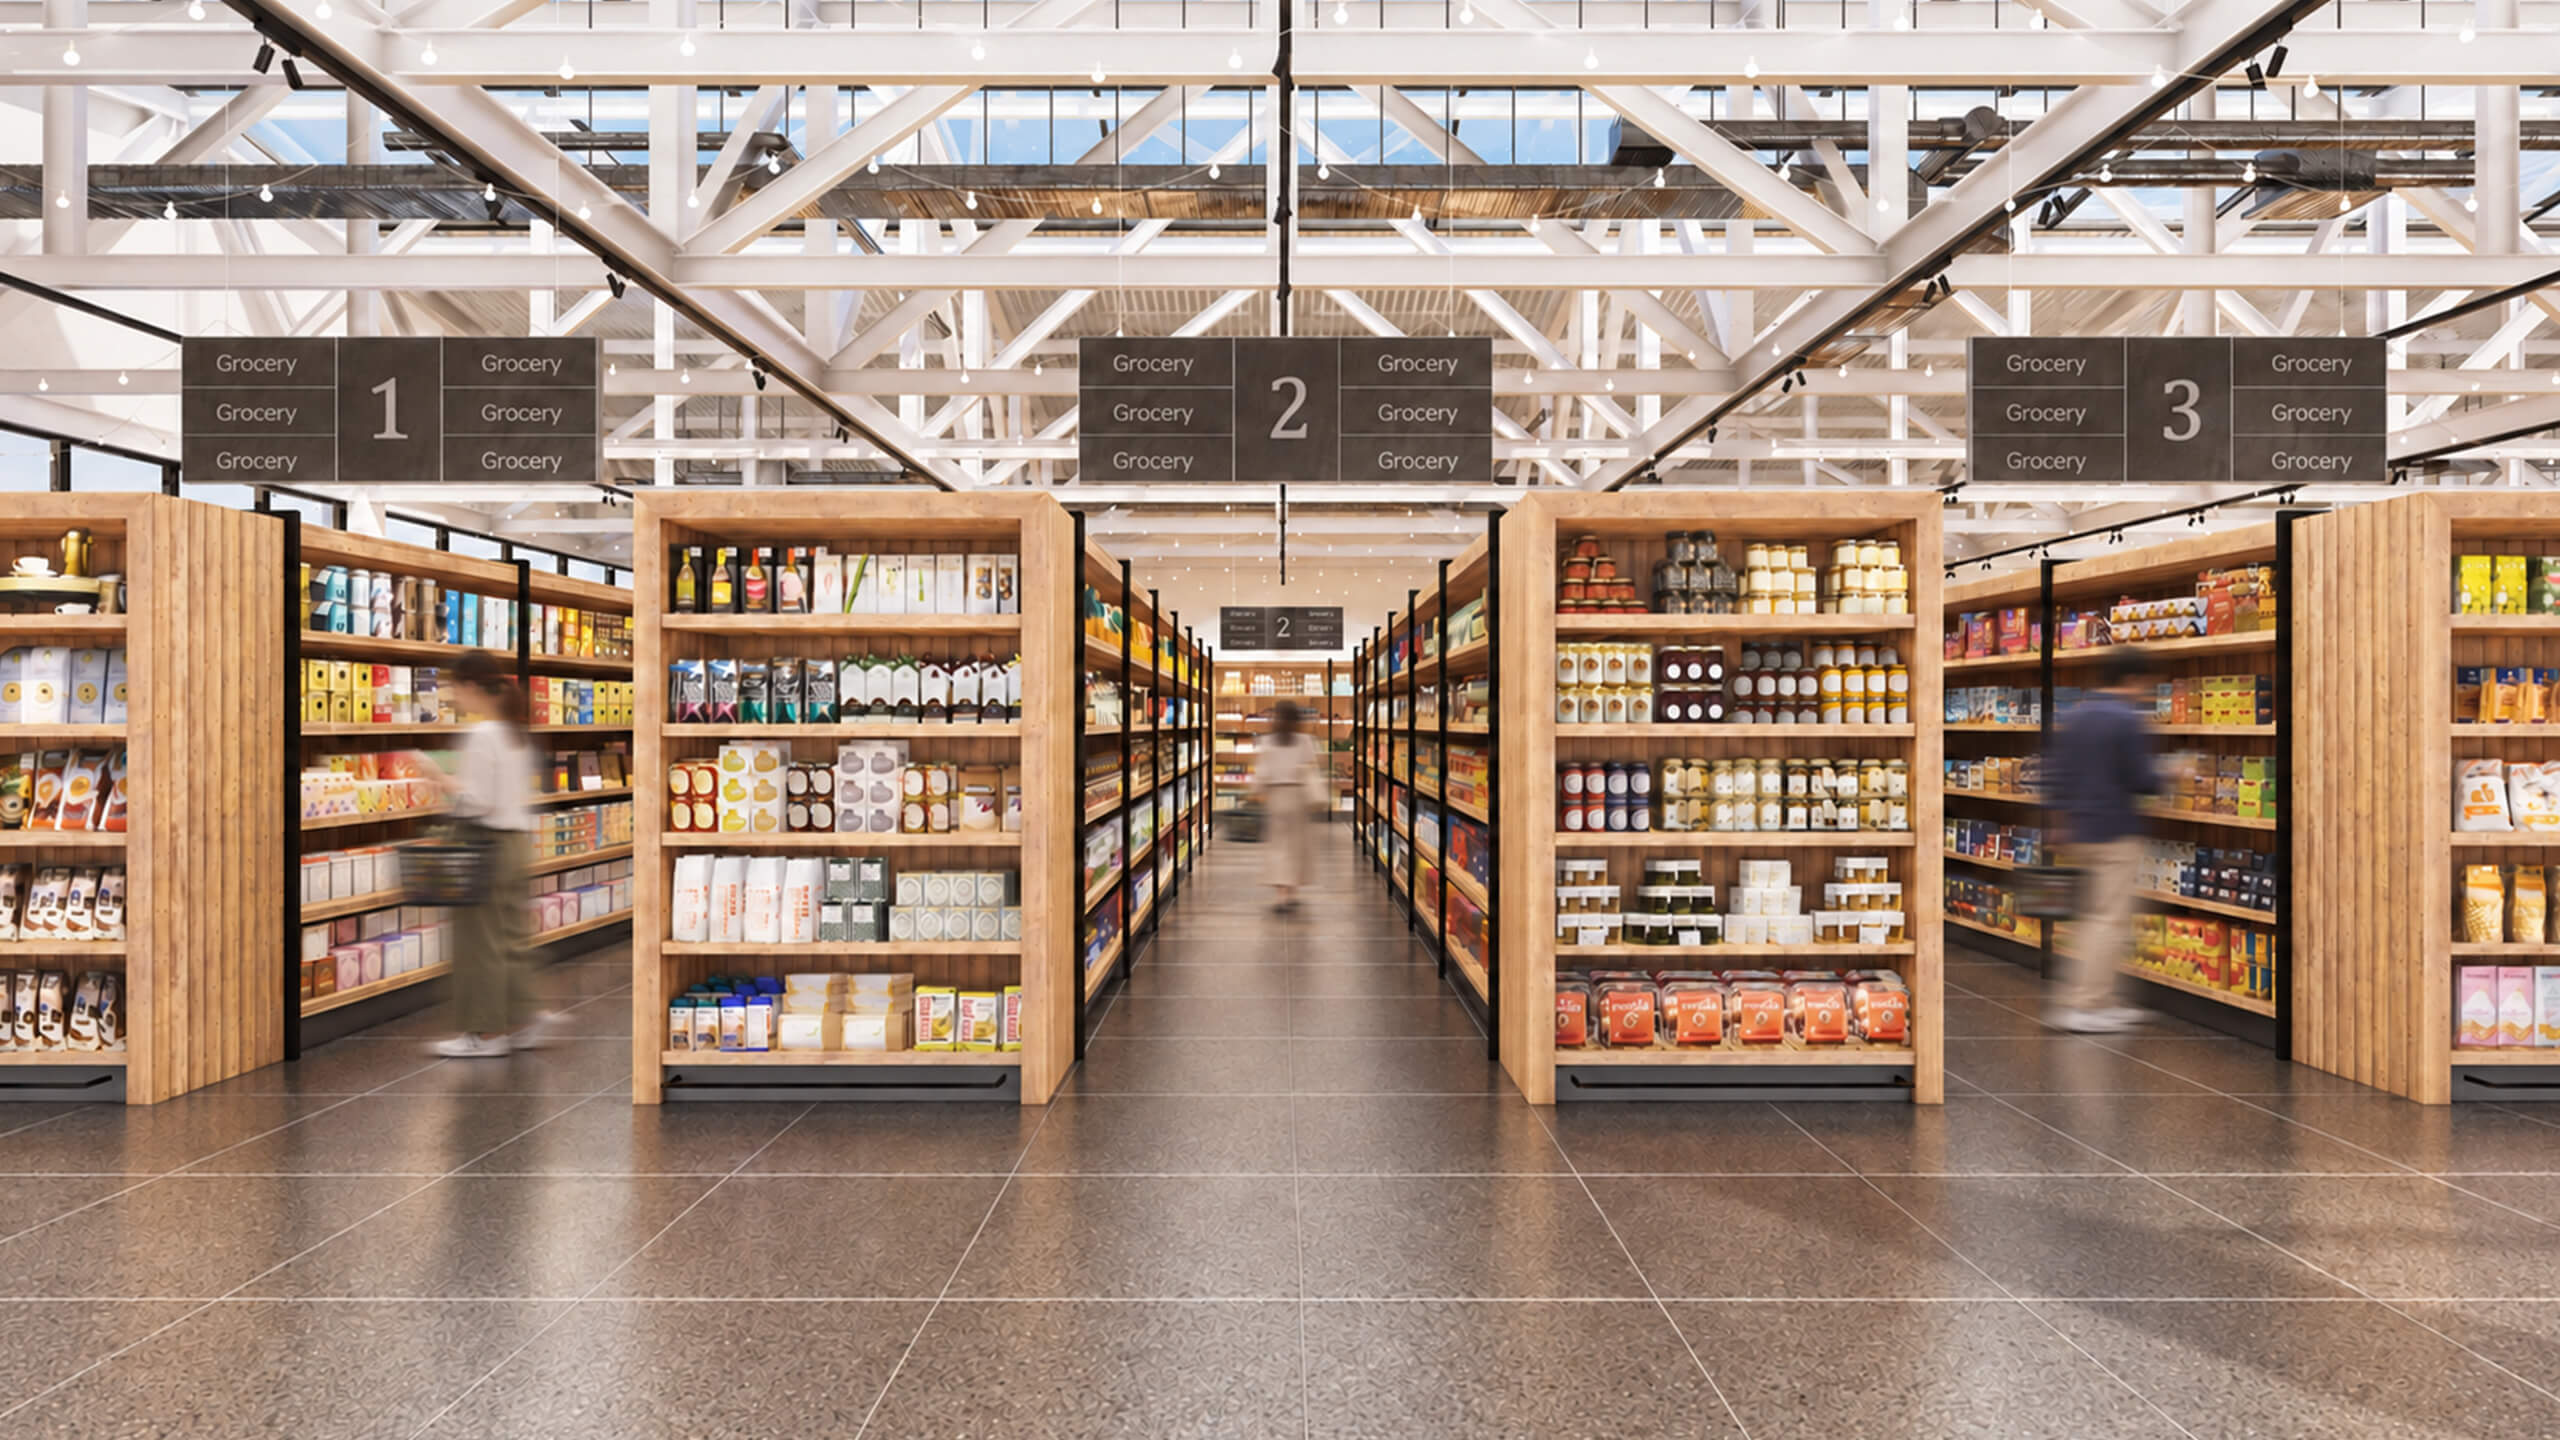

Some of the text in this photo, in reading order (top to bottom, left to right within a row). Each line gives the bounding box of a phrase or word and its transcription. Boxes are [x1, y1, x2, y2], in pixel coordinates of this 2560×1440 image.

[216, 353, 298, 377] Grocery
[481, 353, 563, 377] Grocery
[1112, 353, 1194, 377] Grocery
[1377, 353, 1459, 377] Grocery
[2006, 353, 2087, 377] Grocery
[2271, 353, 2353, 377] Grocery
[216, 403, 298, 426] Grocery
[371, 376, 409, 440] 1
[481, 403, 563, 426] Grocery
[1112, 403, 1194, 426] Grocery
[1269, 376, 1308, 439] 2
[1377, 403, 1459, 426] Grocery
[2006, 403, 2087, 426] Grocery
[2162, 378, 2202, 441] 3
[2271, 403, 2353, 426] Grocery
[216, 451, 298, 474] Grocery
[481, 451, 563, 474] Grocery
[1112, 451, 1194, 474] Grocery
[1377, 451, 1459, 474] Grocery
[2006, 451, 2087, 474] Grocery
[2271, 451, 2353, 474] Grocery
[1276, 616, 1291, 638] 2
